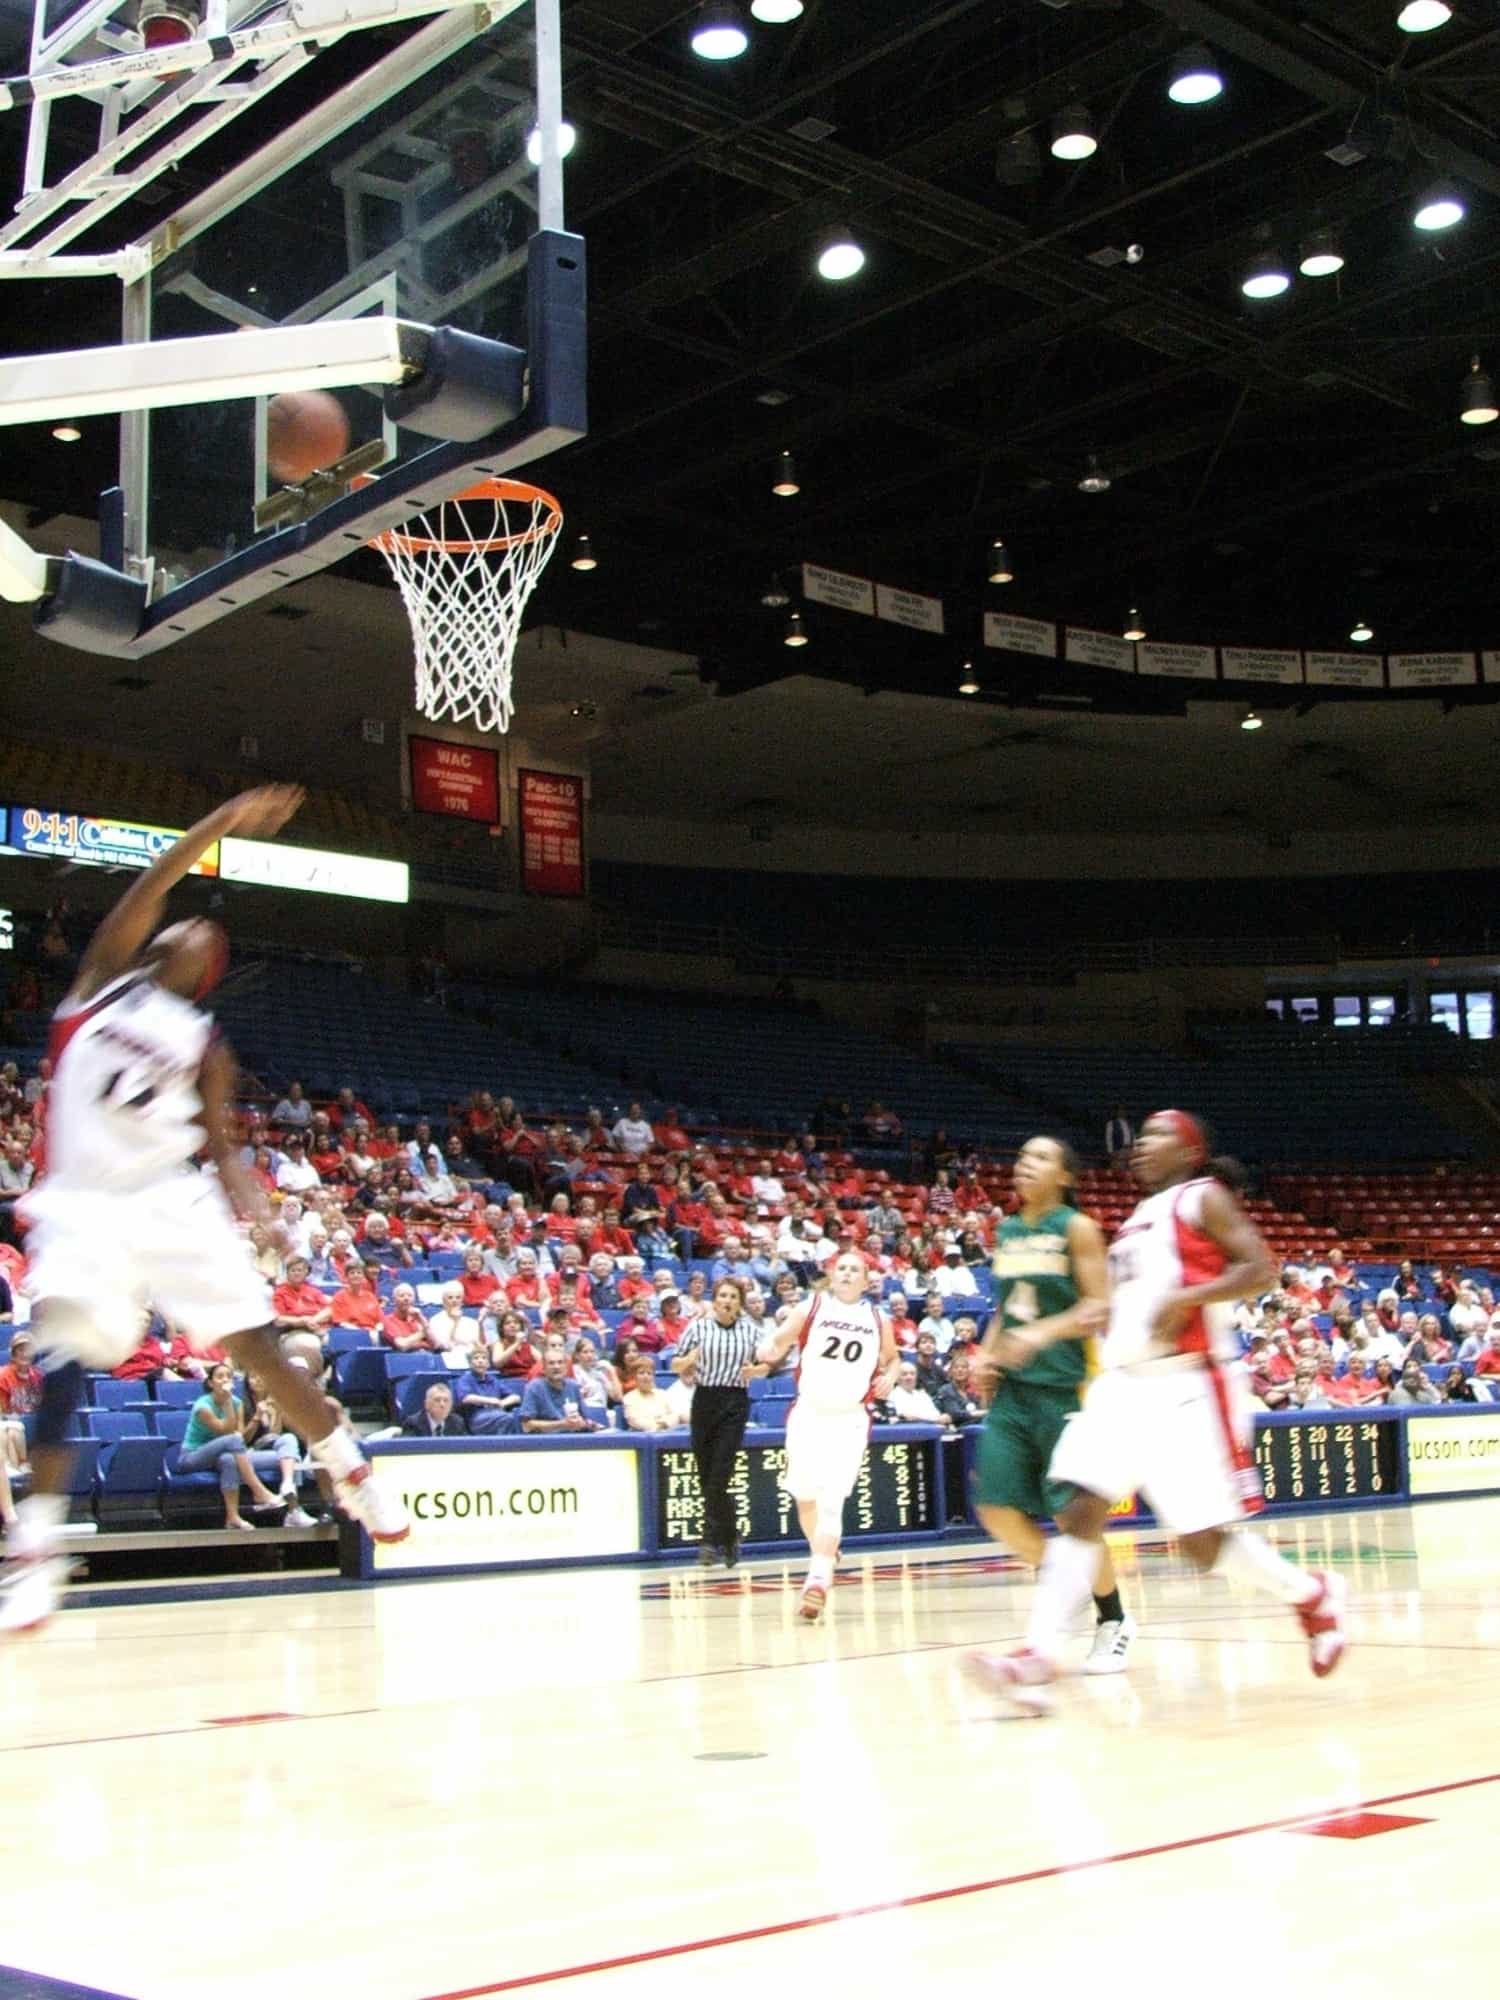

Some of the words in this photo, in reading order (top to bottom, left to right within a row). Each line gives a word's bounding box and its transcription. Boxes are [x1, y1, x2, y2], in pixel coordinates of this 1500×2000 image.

[436, 749, 473, 769] WAC
[525, 777, 576, 796] Pac-10
[822, 1336, 863, 1363] 20
[1289, 1427, 1300, 1444] 5
[1308, 1426, 1328, 1443] 20
[1335, 1424, 1353, 1441] 22
[1360, 1423, 1379, 1440] 34
[882, 1444, 908, 1464] 45
[1311, 1443, 1325, 1460] 11
[1371, 1441, 1377, 1457] 1
[668, 1475, 702, 1497] PTS
[896, 1465, 909, 1485] 8
[1264, 1464, 1275, 1481] 3
[1291, 1462, 1302, 1479] 2
[1318, 1461, 1330, 1477] 4
[1344, 1459, 1356, 1475] 4
[1372, 1457, 1378, 1473] 1
[1264, 1482, 1276, 1499] 0
[1292, 1480, 1304, 1497] 0
[1319, 1478, 1331, 1495] 2
[1345, 1476, 1357, 1493] 2
[1371, 1474, 1383, 1491] 0
[666, 1497, 705, 1519] RBS
[735, 1494, 751, 1515] 3
[777, 1492, 792, 1513] 3
[858, 1488, 872, 1508] 2
[896, 1486, 911, 1506] 2
[666, 1519, 705, 1541] FLS
[780, 1514, 788, 1534] 1
[859, 1509, 873, 1529] 3
[899, 1506, 907, 1526] 1
